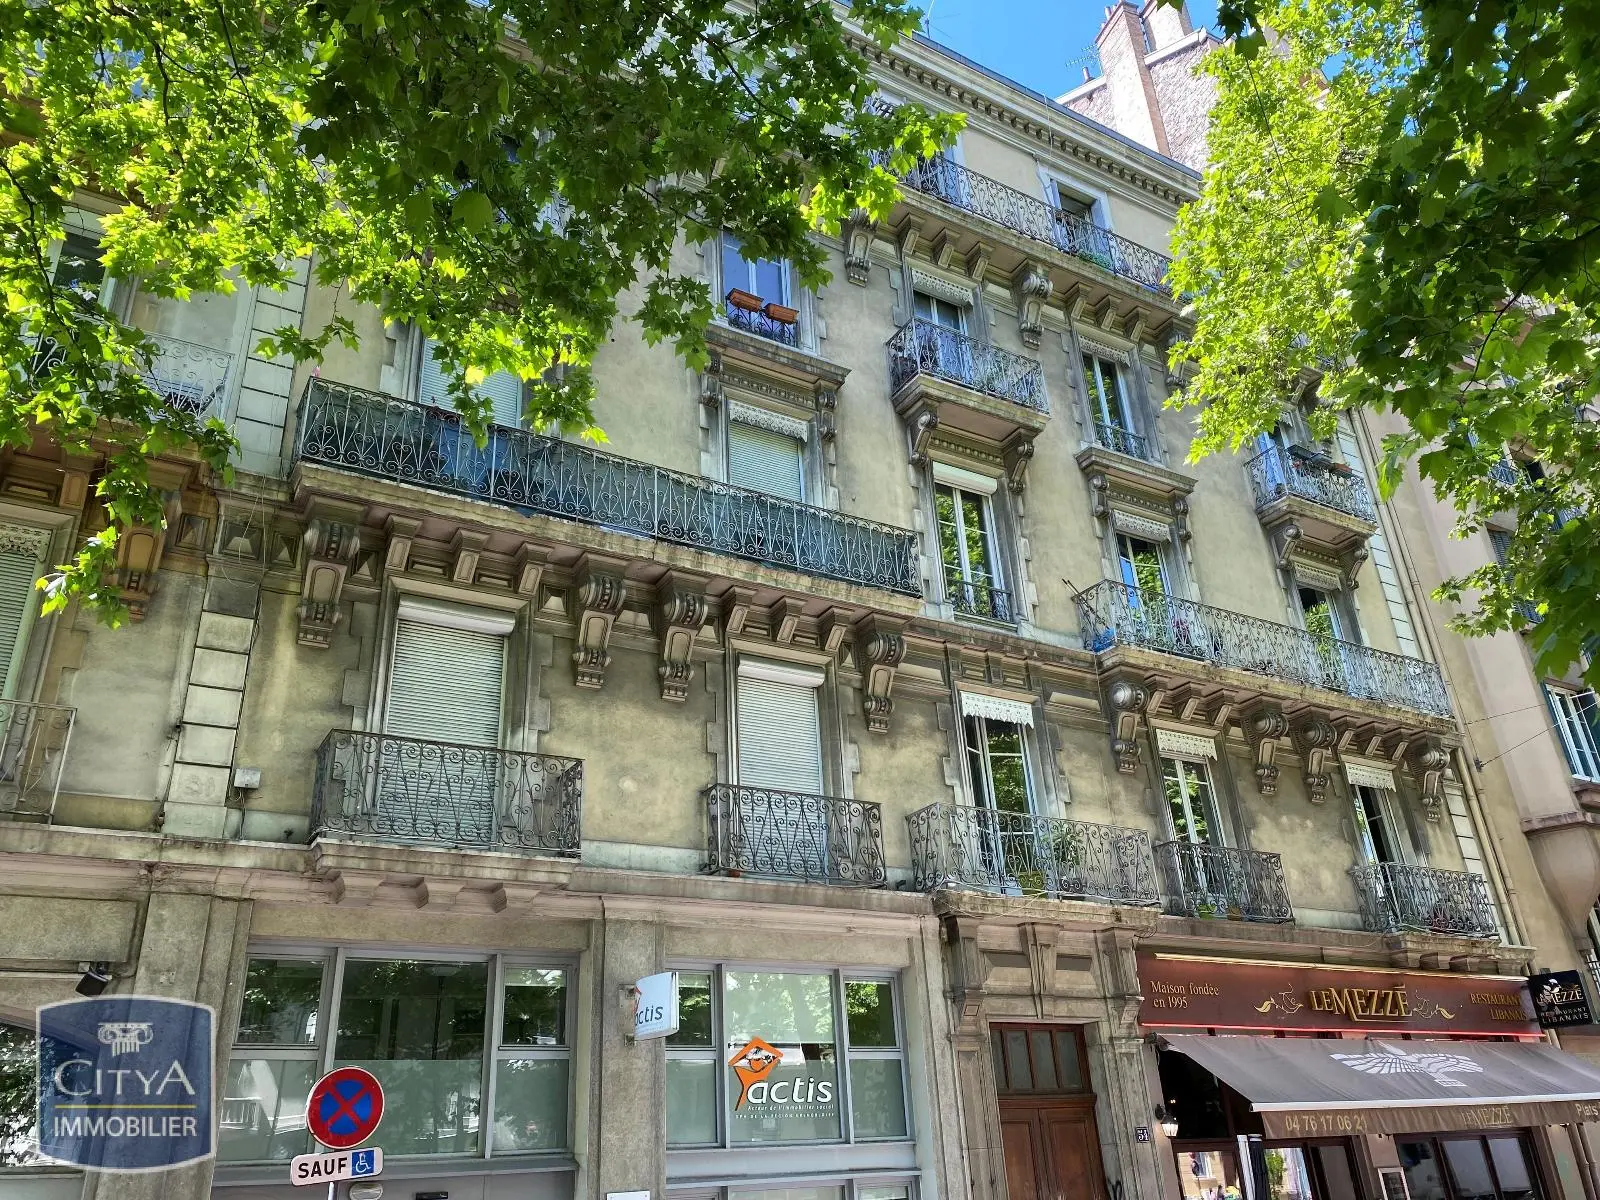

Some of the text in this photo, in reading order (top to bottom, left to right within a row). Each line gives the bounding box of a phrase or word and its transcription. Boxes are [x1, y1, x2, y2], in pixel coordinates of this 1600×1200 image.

[1150, 981, 1220, 996] Maison fondée
[1153, 996, 1188, 1008] en 1995
[1543, 1013, 1588, 1023] LIBANAIS
[747, 1077, 832, 1104] actis
[1575, 1103, 1599, 1117] Plats
[1285, 1114, 1367, 1132] 04 76 17 06 21
[298, 1157, 348, 1179] SAUF
